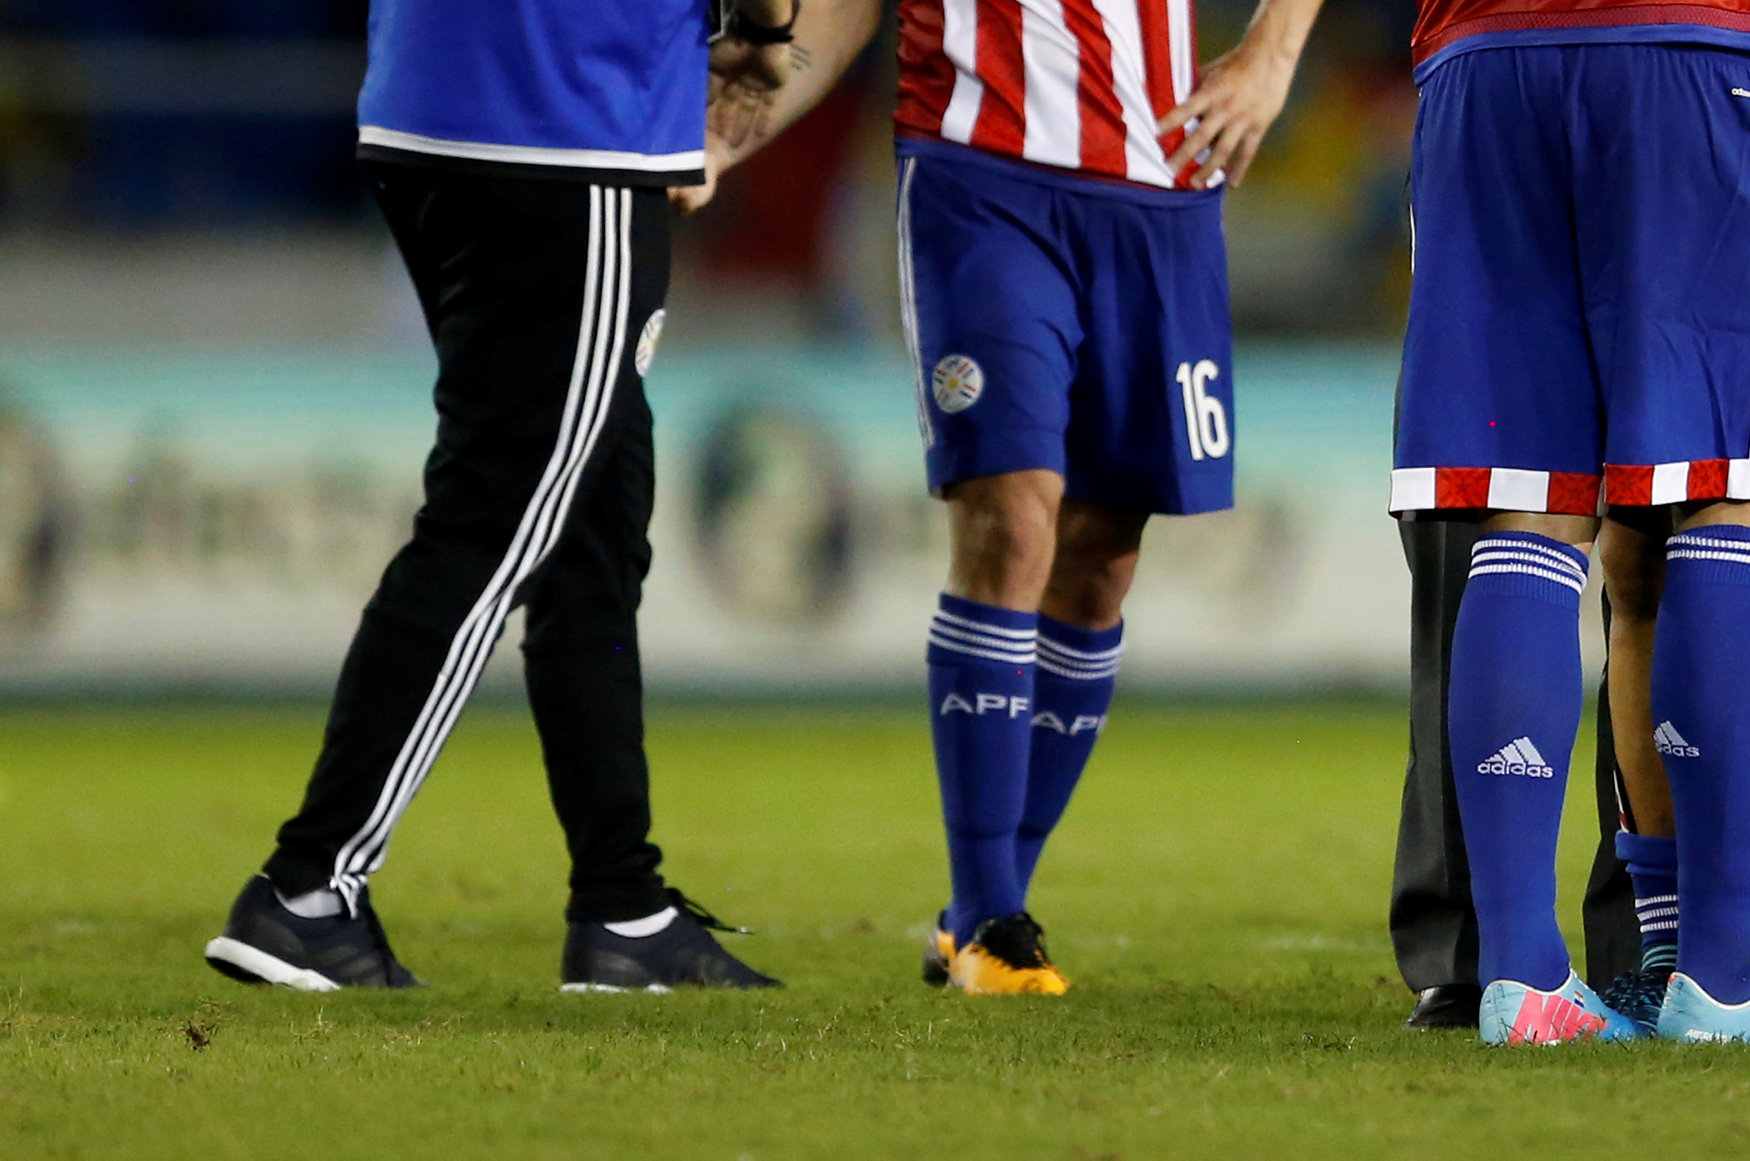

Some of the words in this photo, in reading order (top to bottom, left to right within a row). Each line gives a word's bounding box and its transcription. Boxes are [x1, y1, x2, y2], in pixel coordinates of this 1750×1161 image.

[1176, 359, 1230, 462] 16
[940, 693, 1030, 720] APF
[1477, 760, 1554, 779] adidas
